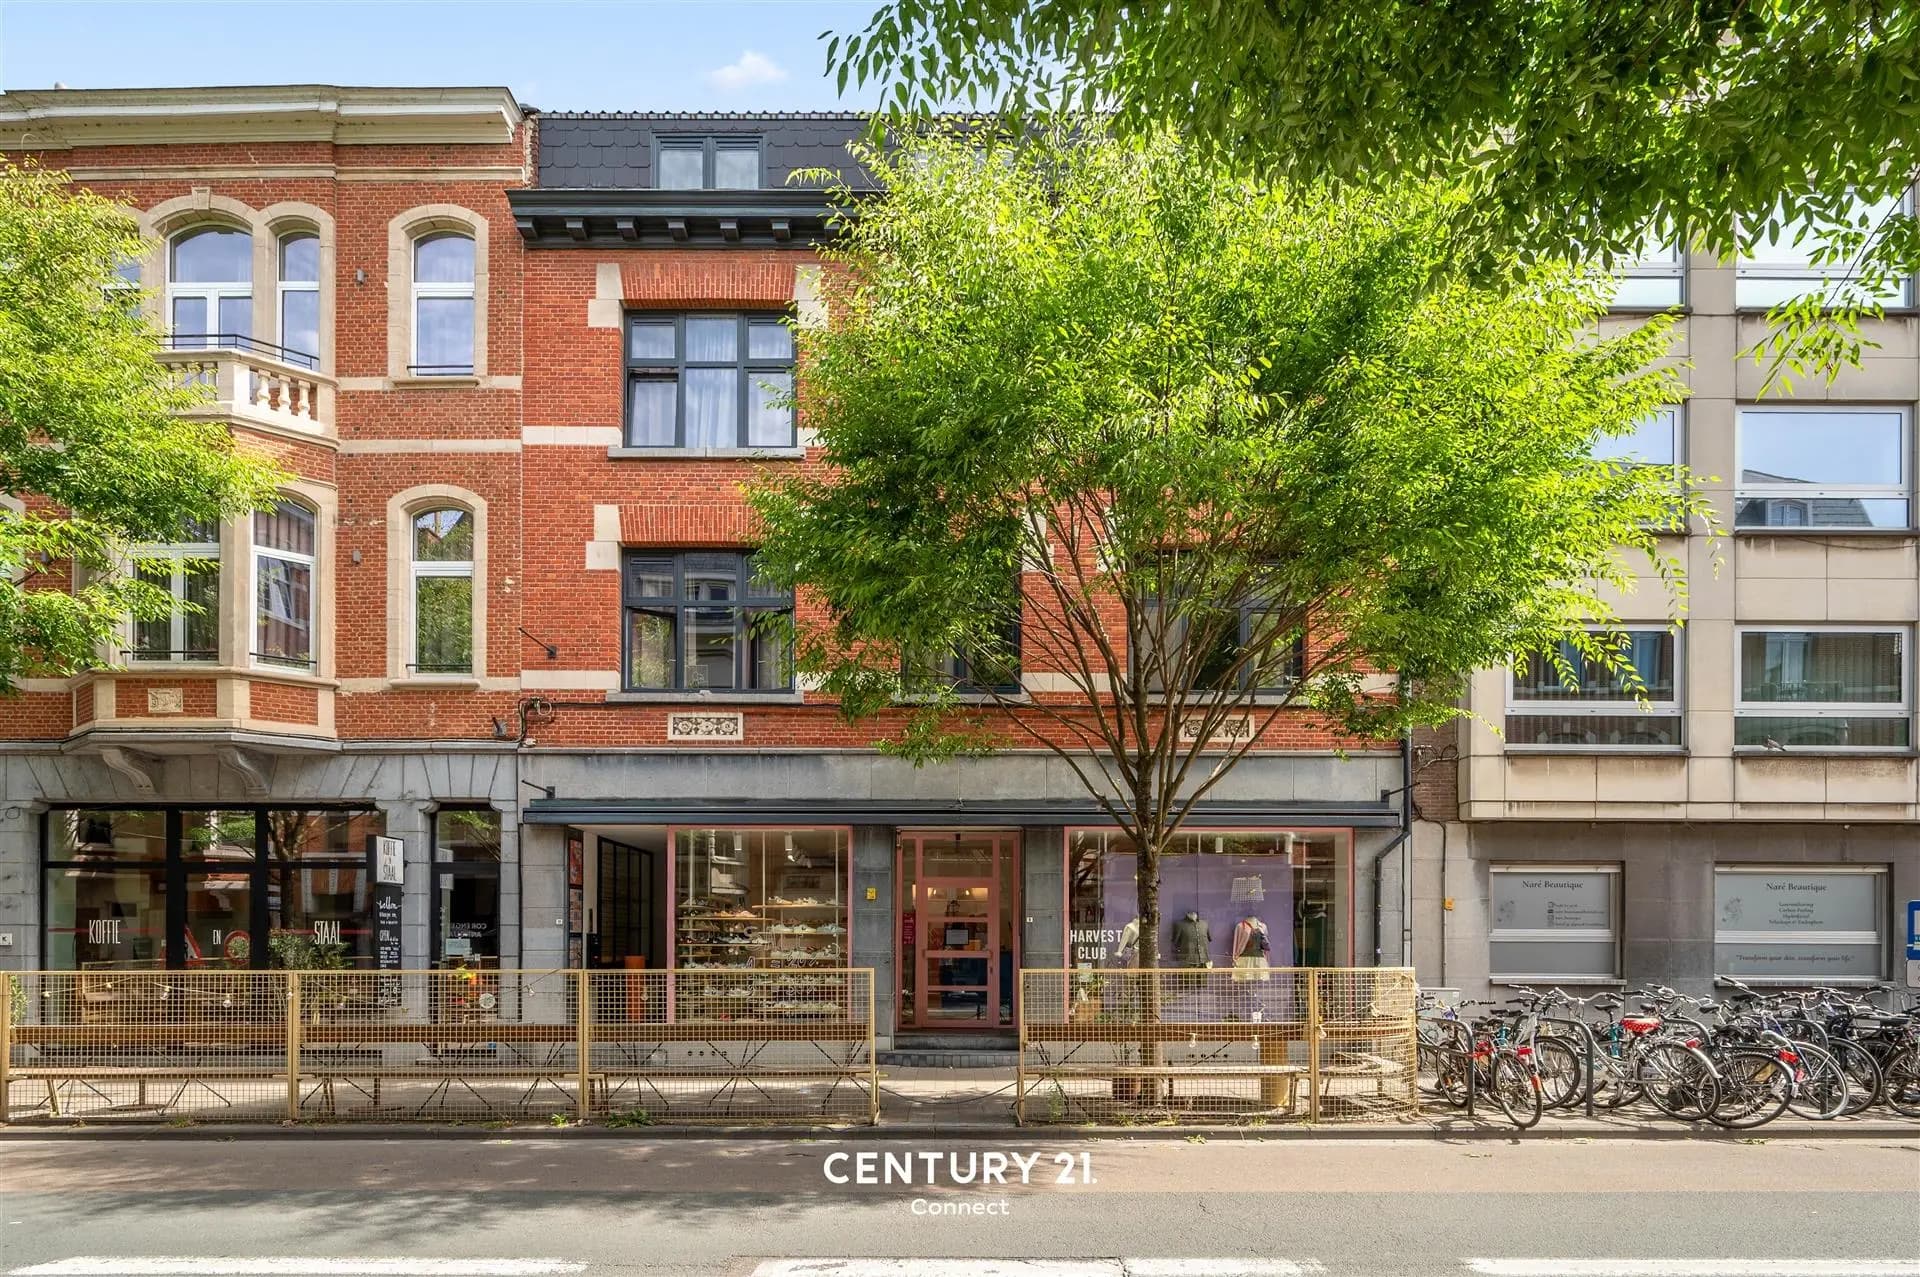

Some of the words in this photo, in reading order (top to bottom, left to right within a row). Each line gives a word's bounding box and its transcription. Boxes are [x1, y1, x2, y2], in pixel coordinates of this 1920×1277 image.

[1522, 880, 1542, 889] Naré
[1544, 880, 1584, 891] Beautique
[1766, 882, 1786, 891] Naré
[1788, 882, 1828, 893] Beautique
[88, 919, 121, 944] KOFFIE
[212, 929, 222, 945] EN
[314, 920, 343, 945] STAAL
[1070, 929, 1122, 943] HARVEST
[1078, 946, 1107, 960] CLUB
